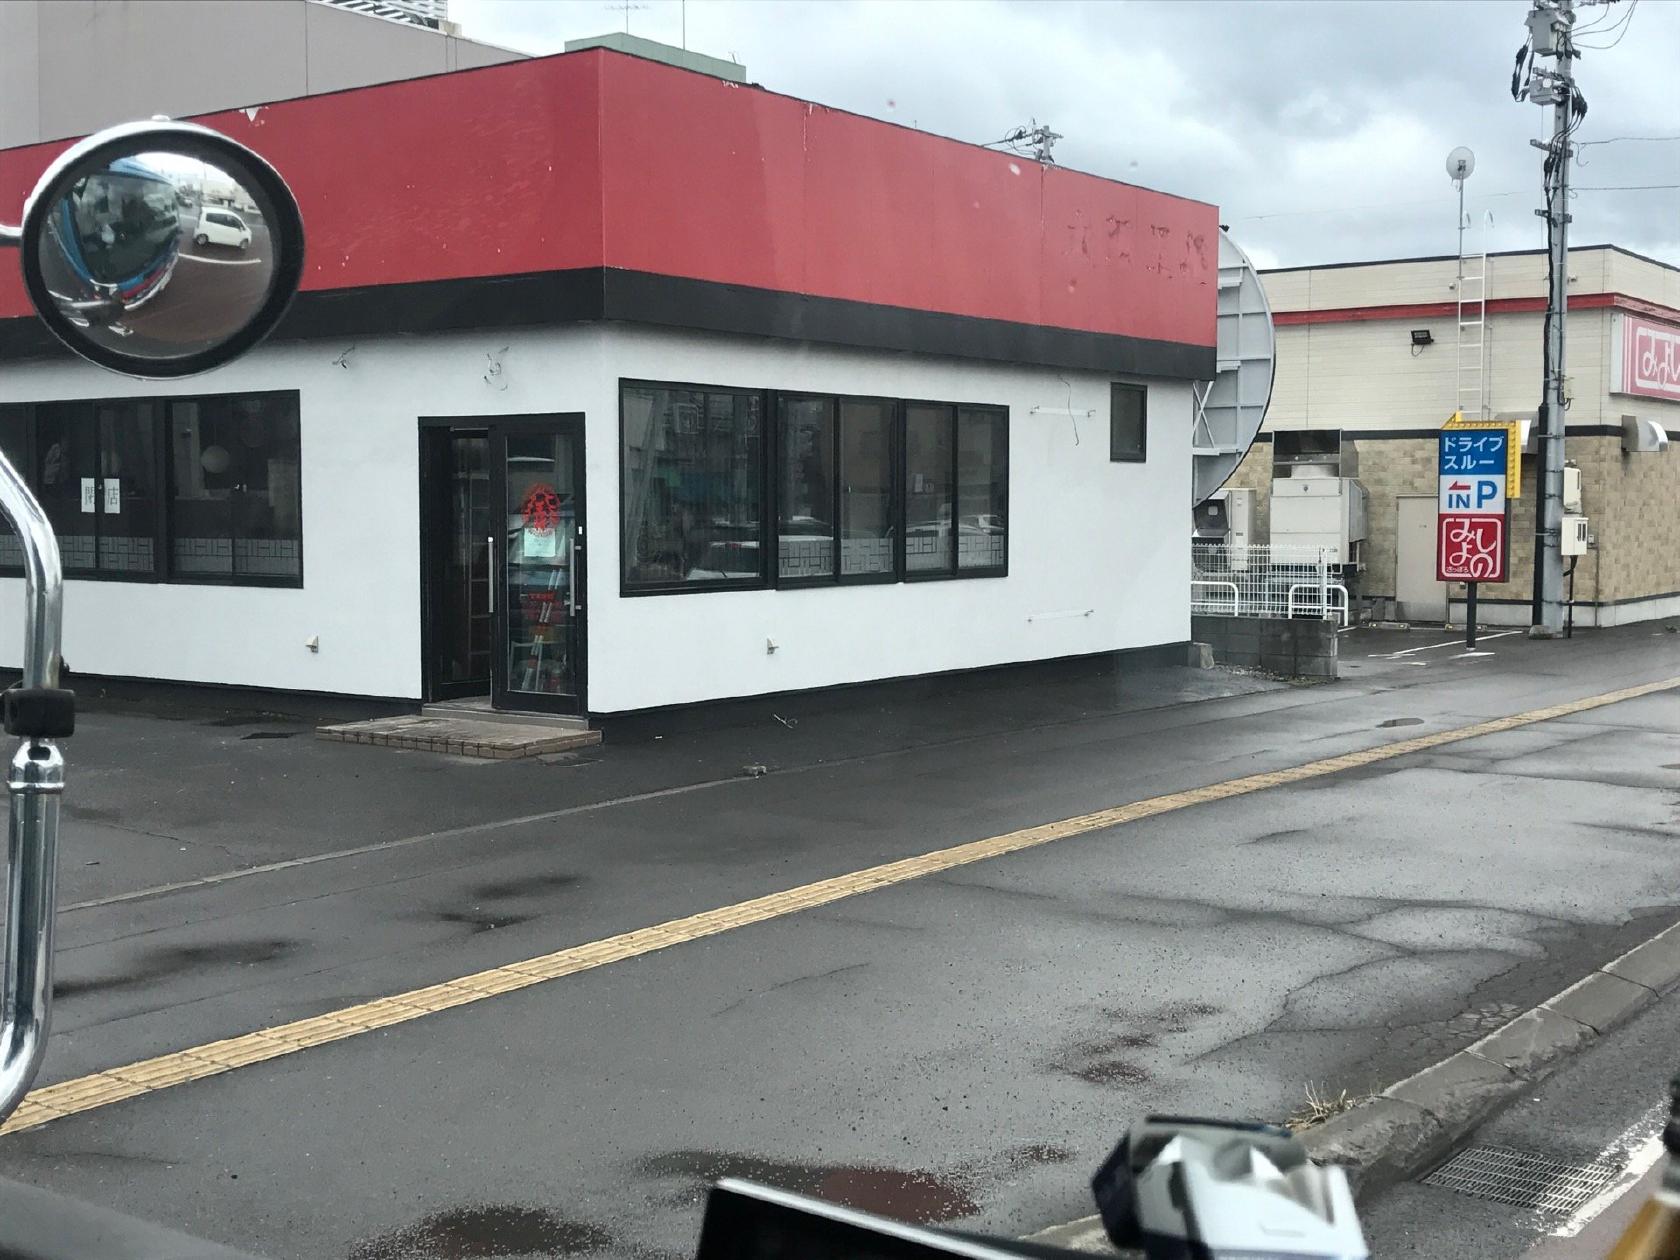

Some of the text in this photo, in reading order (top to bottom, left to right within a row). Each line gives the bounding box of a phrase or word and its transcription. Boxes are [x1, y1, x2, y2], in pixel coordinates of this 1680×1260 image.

[1444, 436, 1504, 452] ドライブ
[1444, 455, 1494, 470] スルー
[1447, 480, 1498, 509] IN P
[1449, 518, 1497, 578] みよしの
